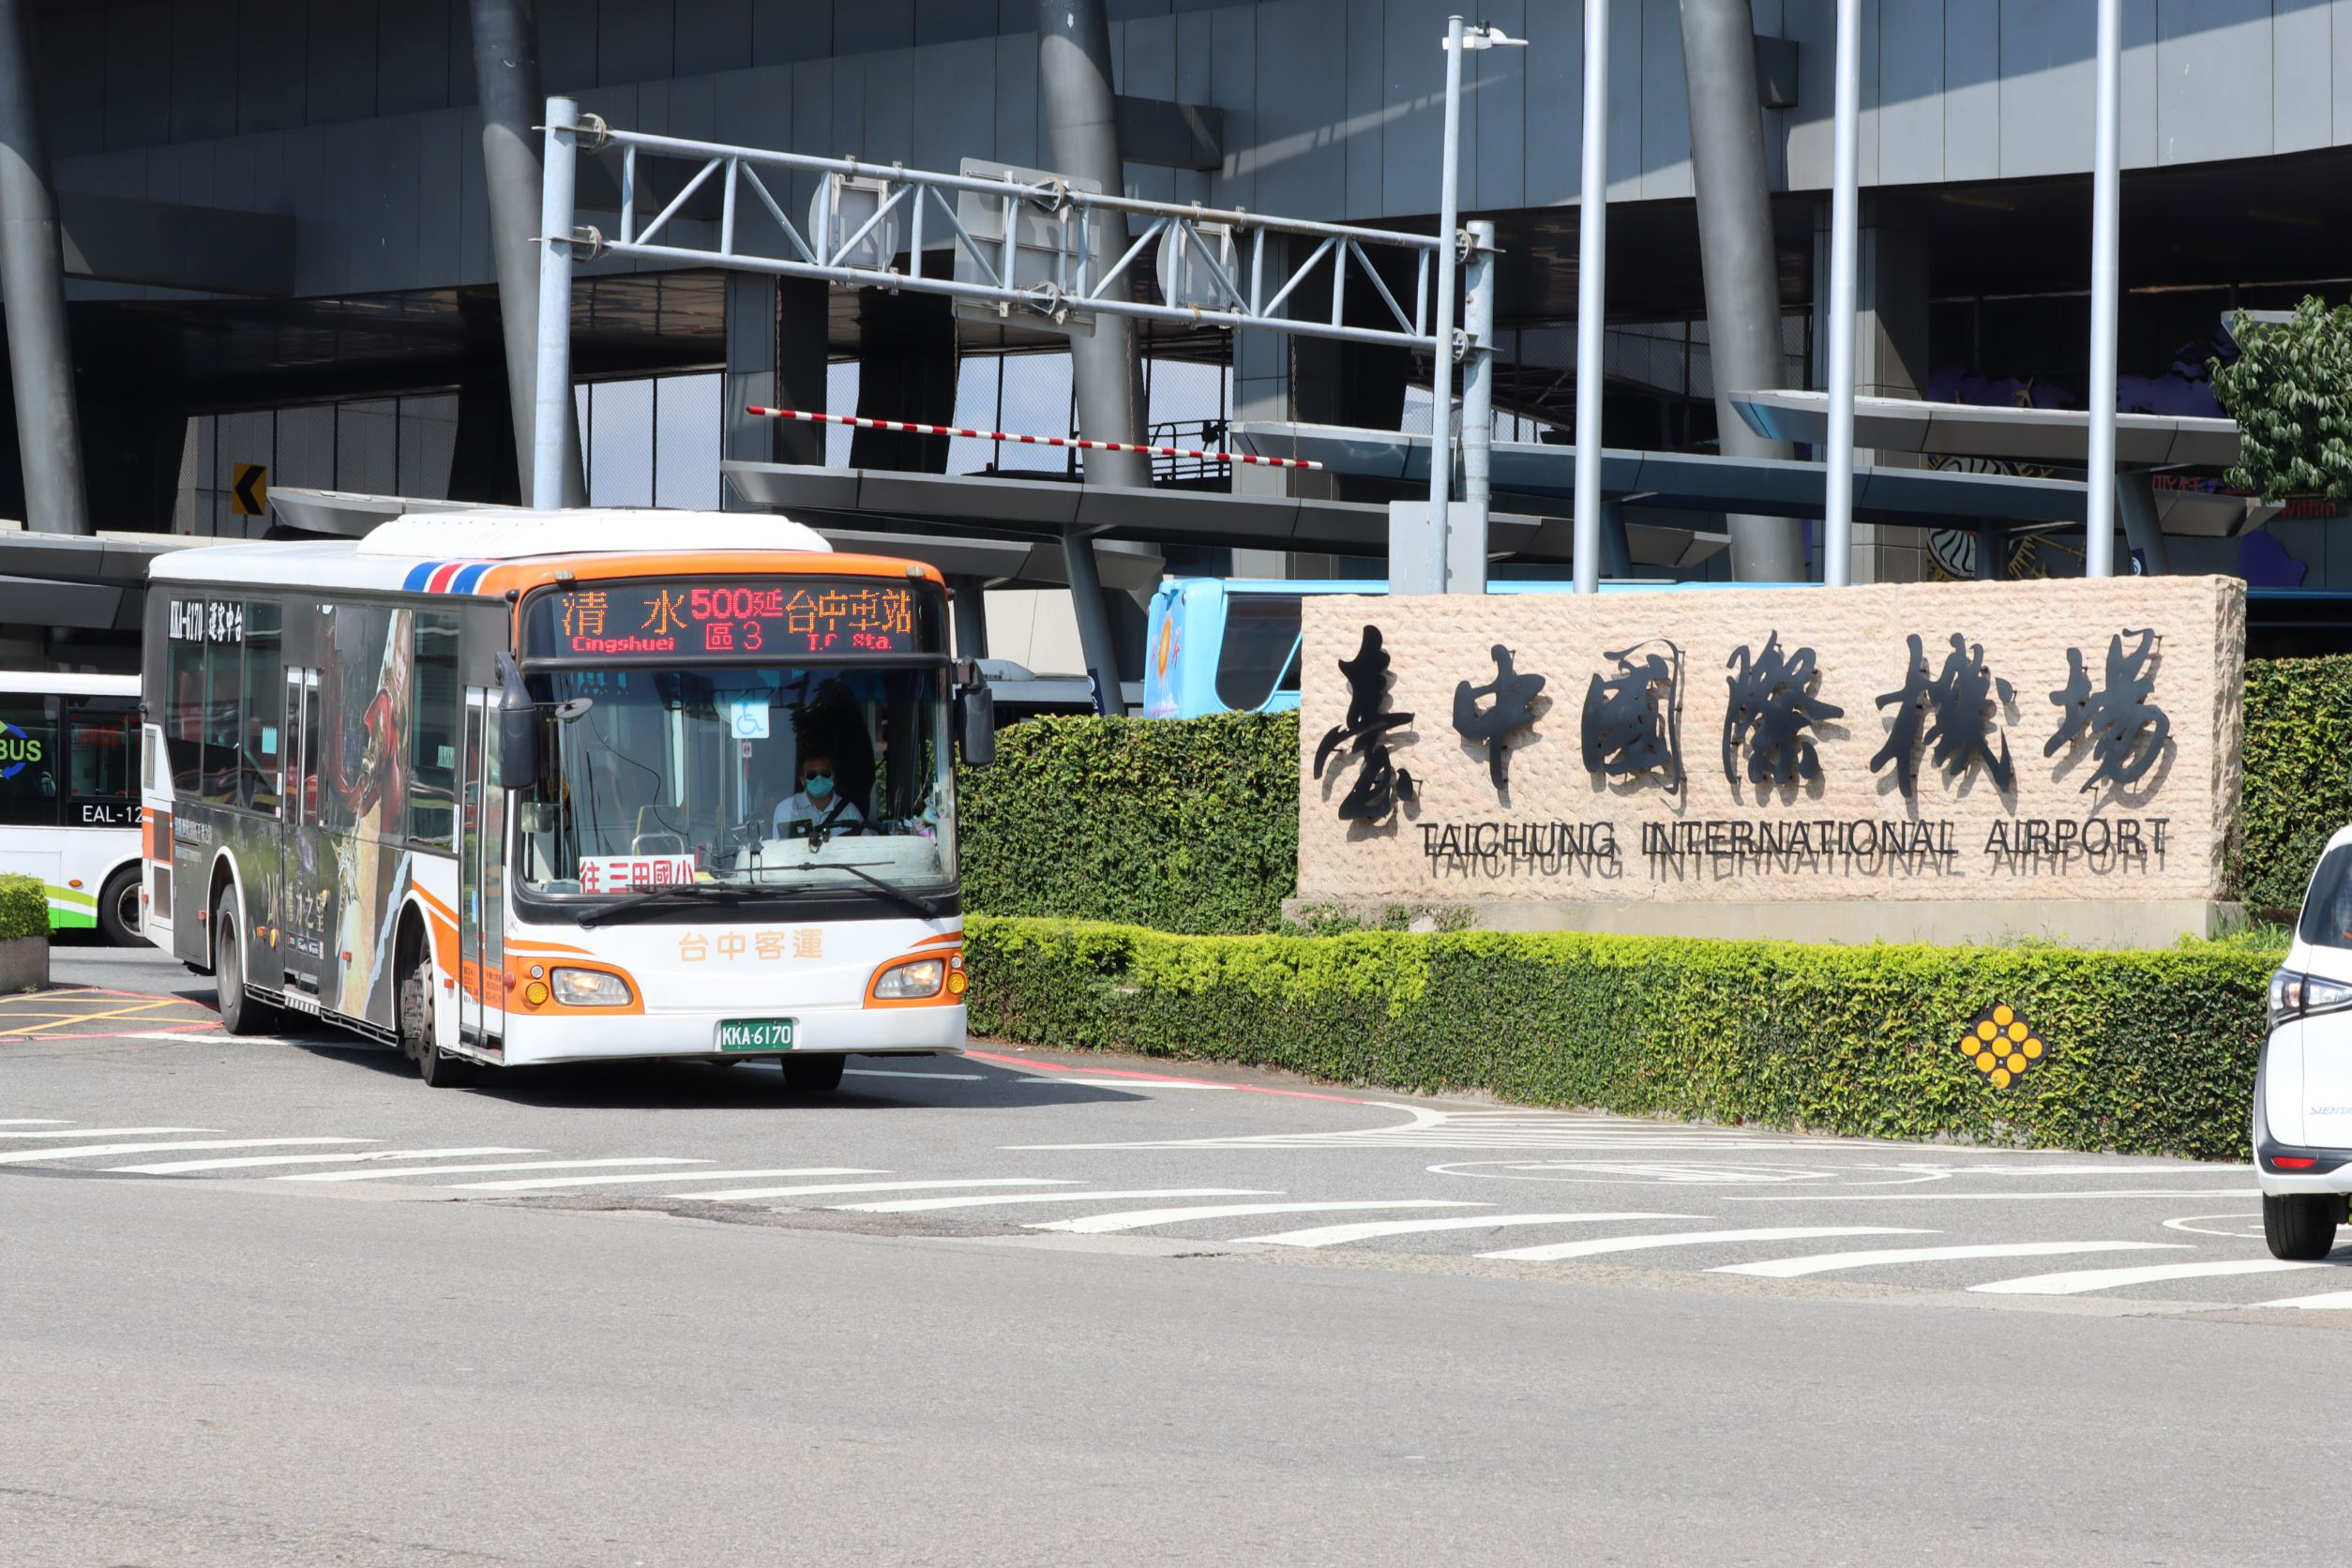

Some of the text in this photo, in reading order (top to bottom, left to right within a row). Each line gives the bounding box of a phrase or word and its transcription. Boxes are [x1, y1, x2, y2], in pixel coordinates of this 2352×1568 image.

[170, 600, 204, 641] KKA-6170
[572, 635, 674, 653] Cingshuei
[1416, 818, 2171, 857] TAICHUNG INTERNATIONAL AIRPORT
[678, 928, 823, 961] 台中客運
